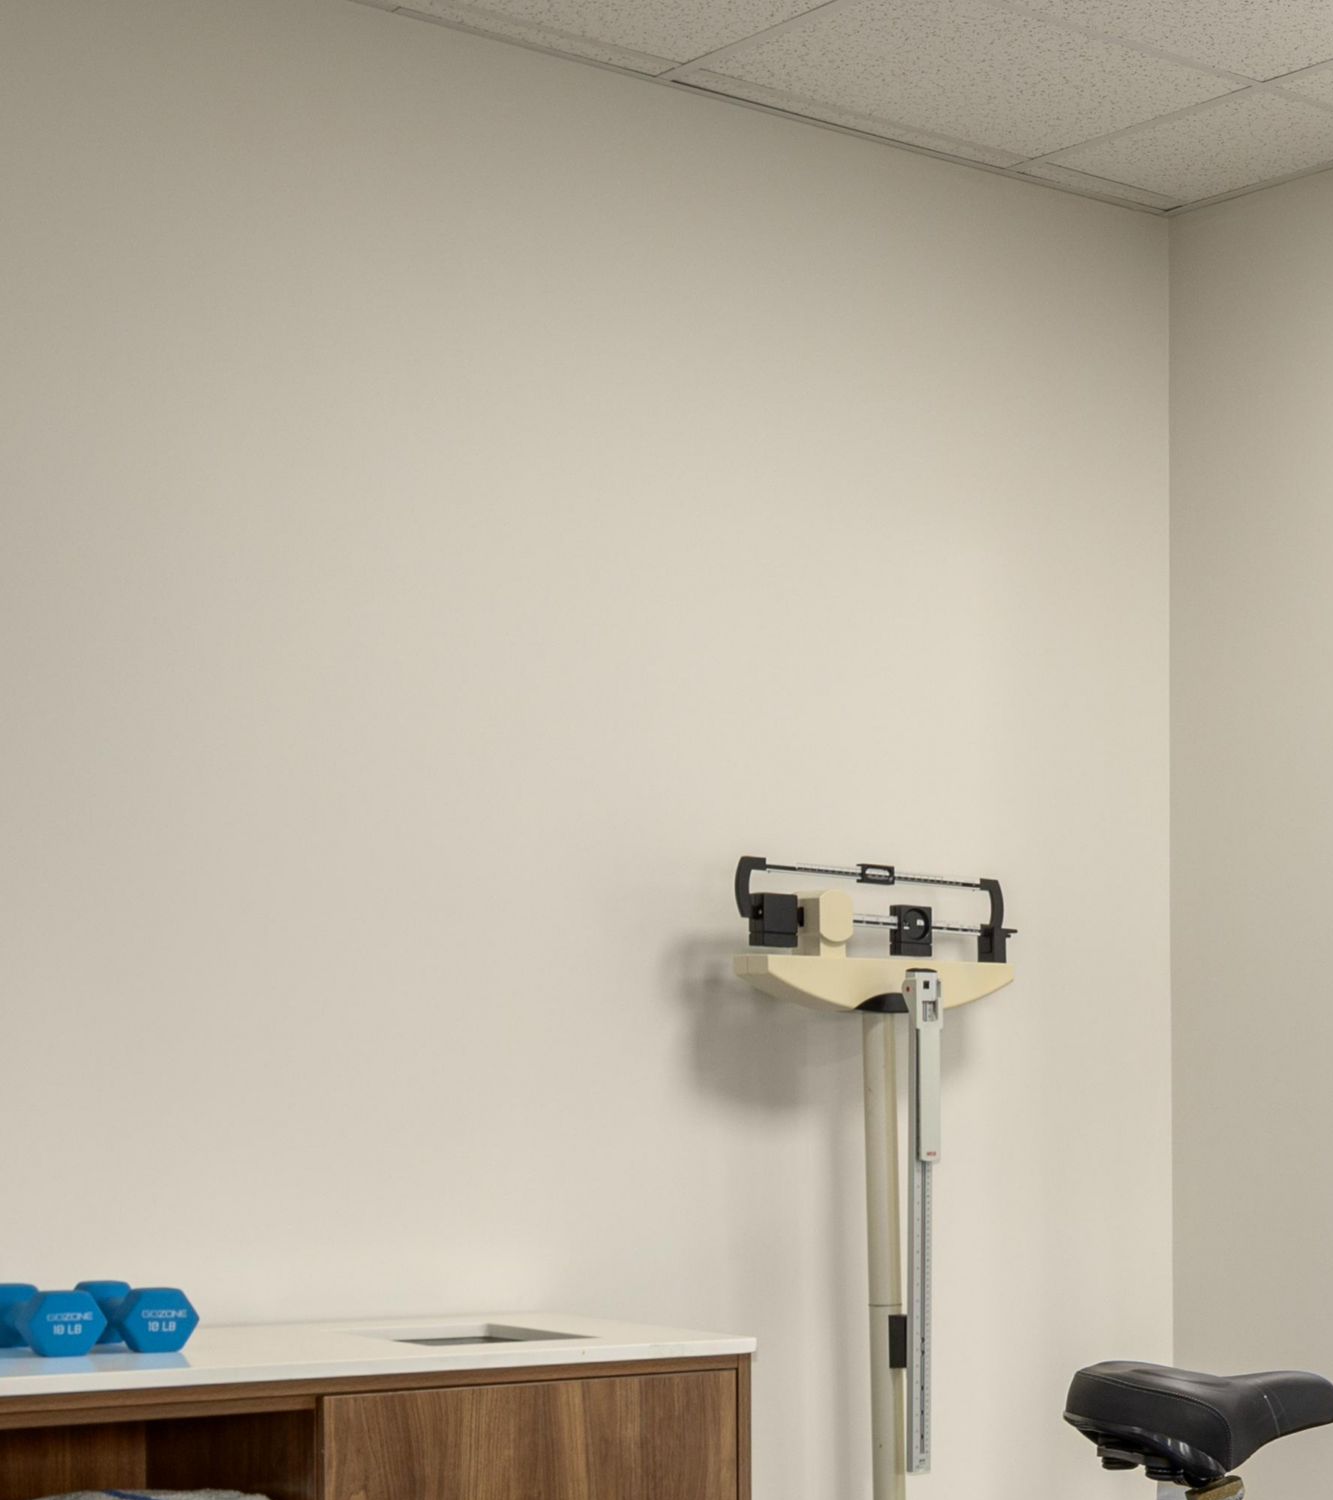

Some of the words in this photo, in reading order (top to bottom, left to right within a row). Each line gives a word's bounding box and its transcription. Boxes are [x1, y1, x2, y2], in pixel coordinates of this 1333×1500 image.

[53, 1324, 65, 1335] 10
[67, 1323, 82, 1335] LB
[148, 1321, 160, 1332] 10
[162, 1321, 177, 1332] LB
